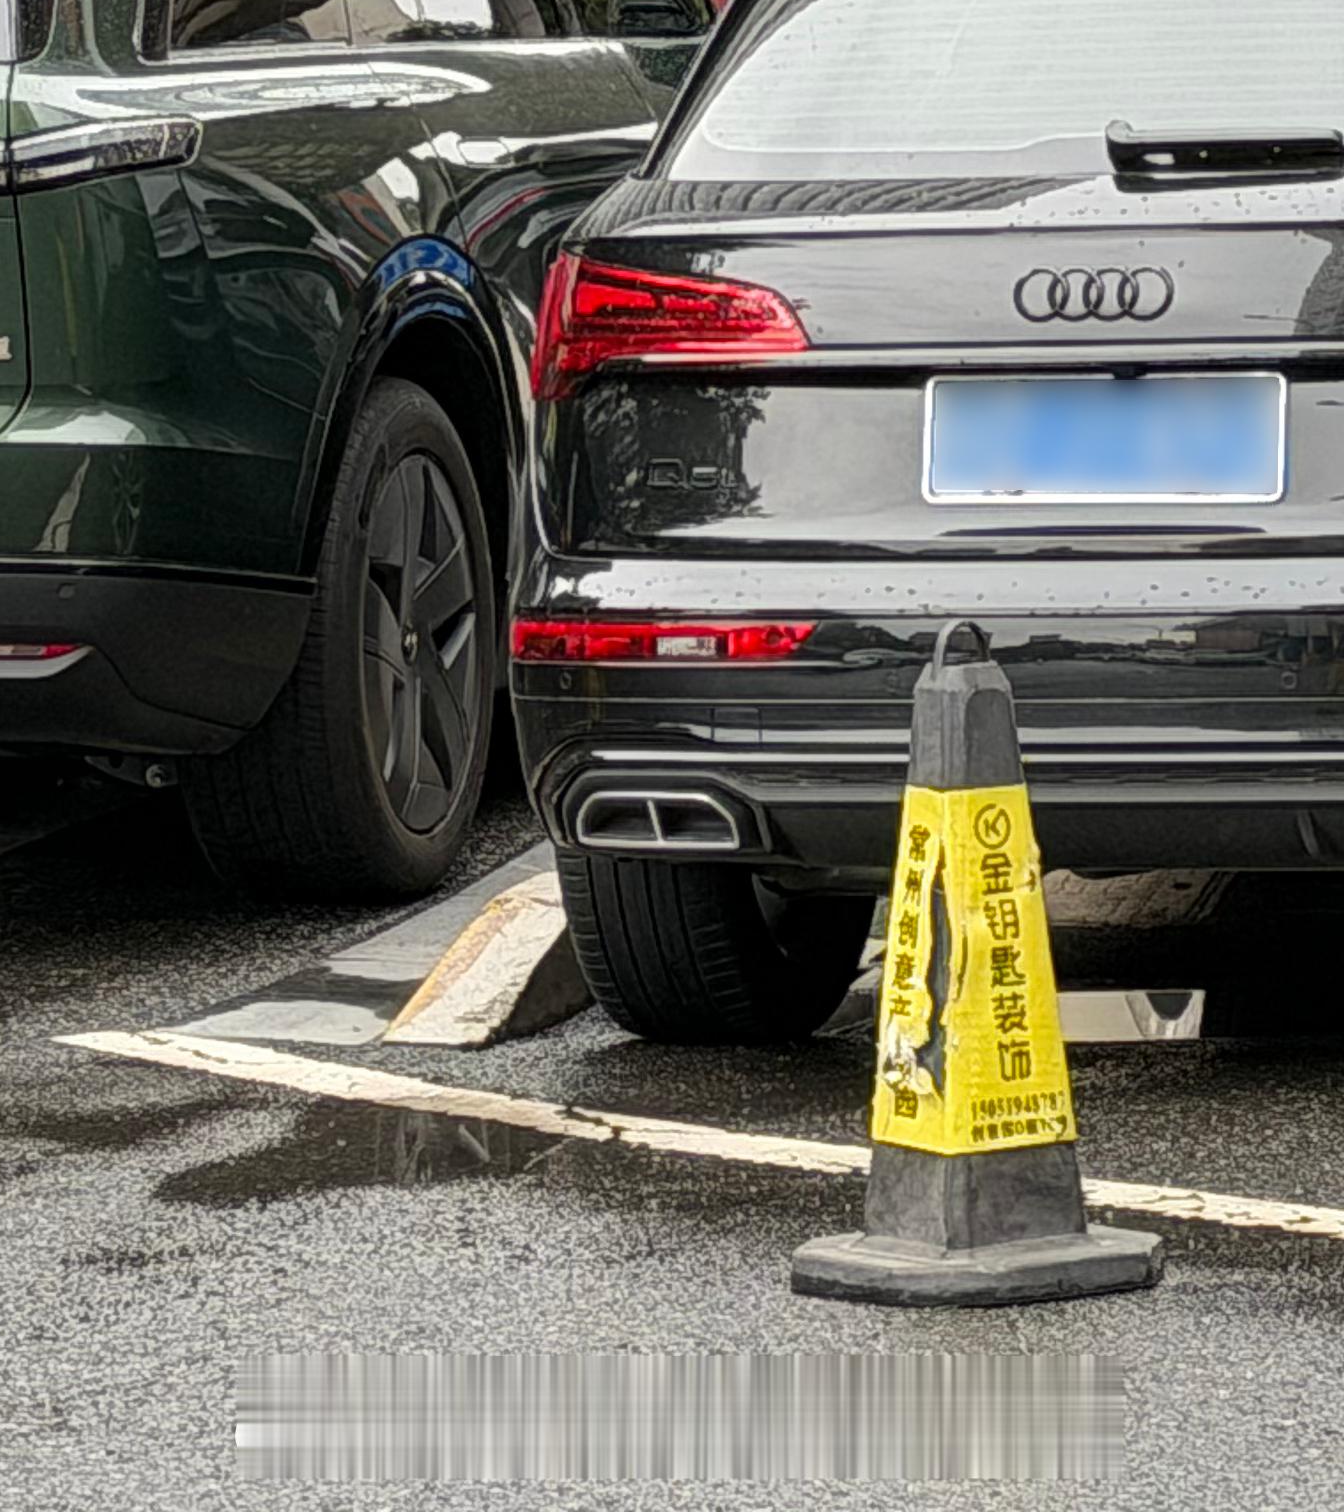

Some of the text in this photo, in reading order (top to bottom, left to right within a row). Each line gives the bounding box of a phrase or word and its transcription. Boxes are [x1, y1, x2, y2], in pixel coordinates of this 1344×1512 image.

[888, 824, 931, 1120] 常州创意产园
[980, 852, 1033, 1082] 金钥匙装饰
